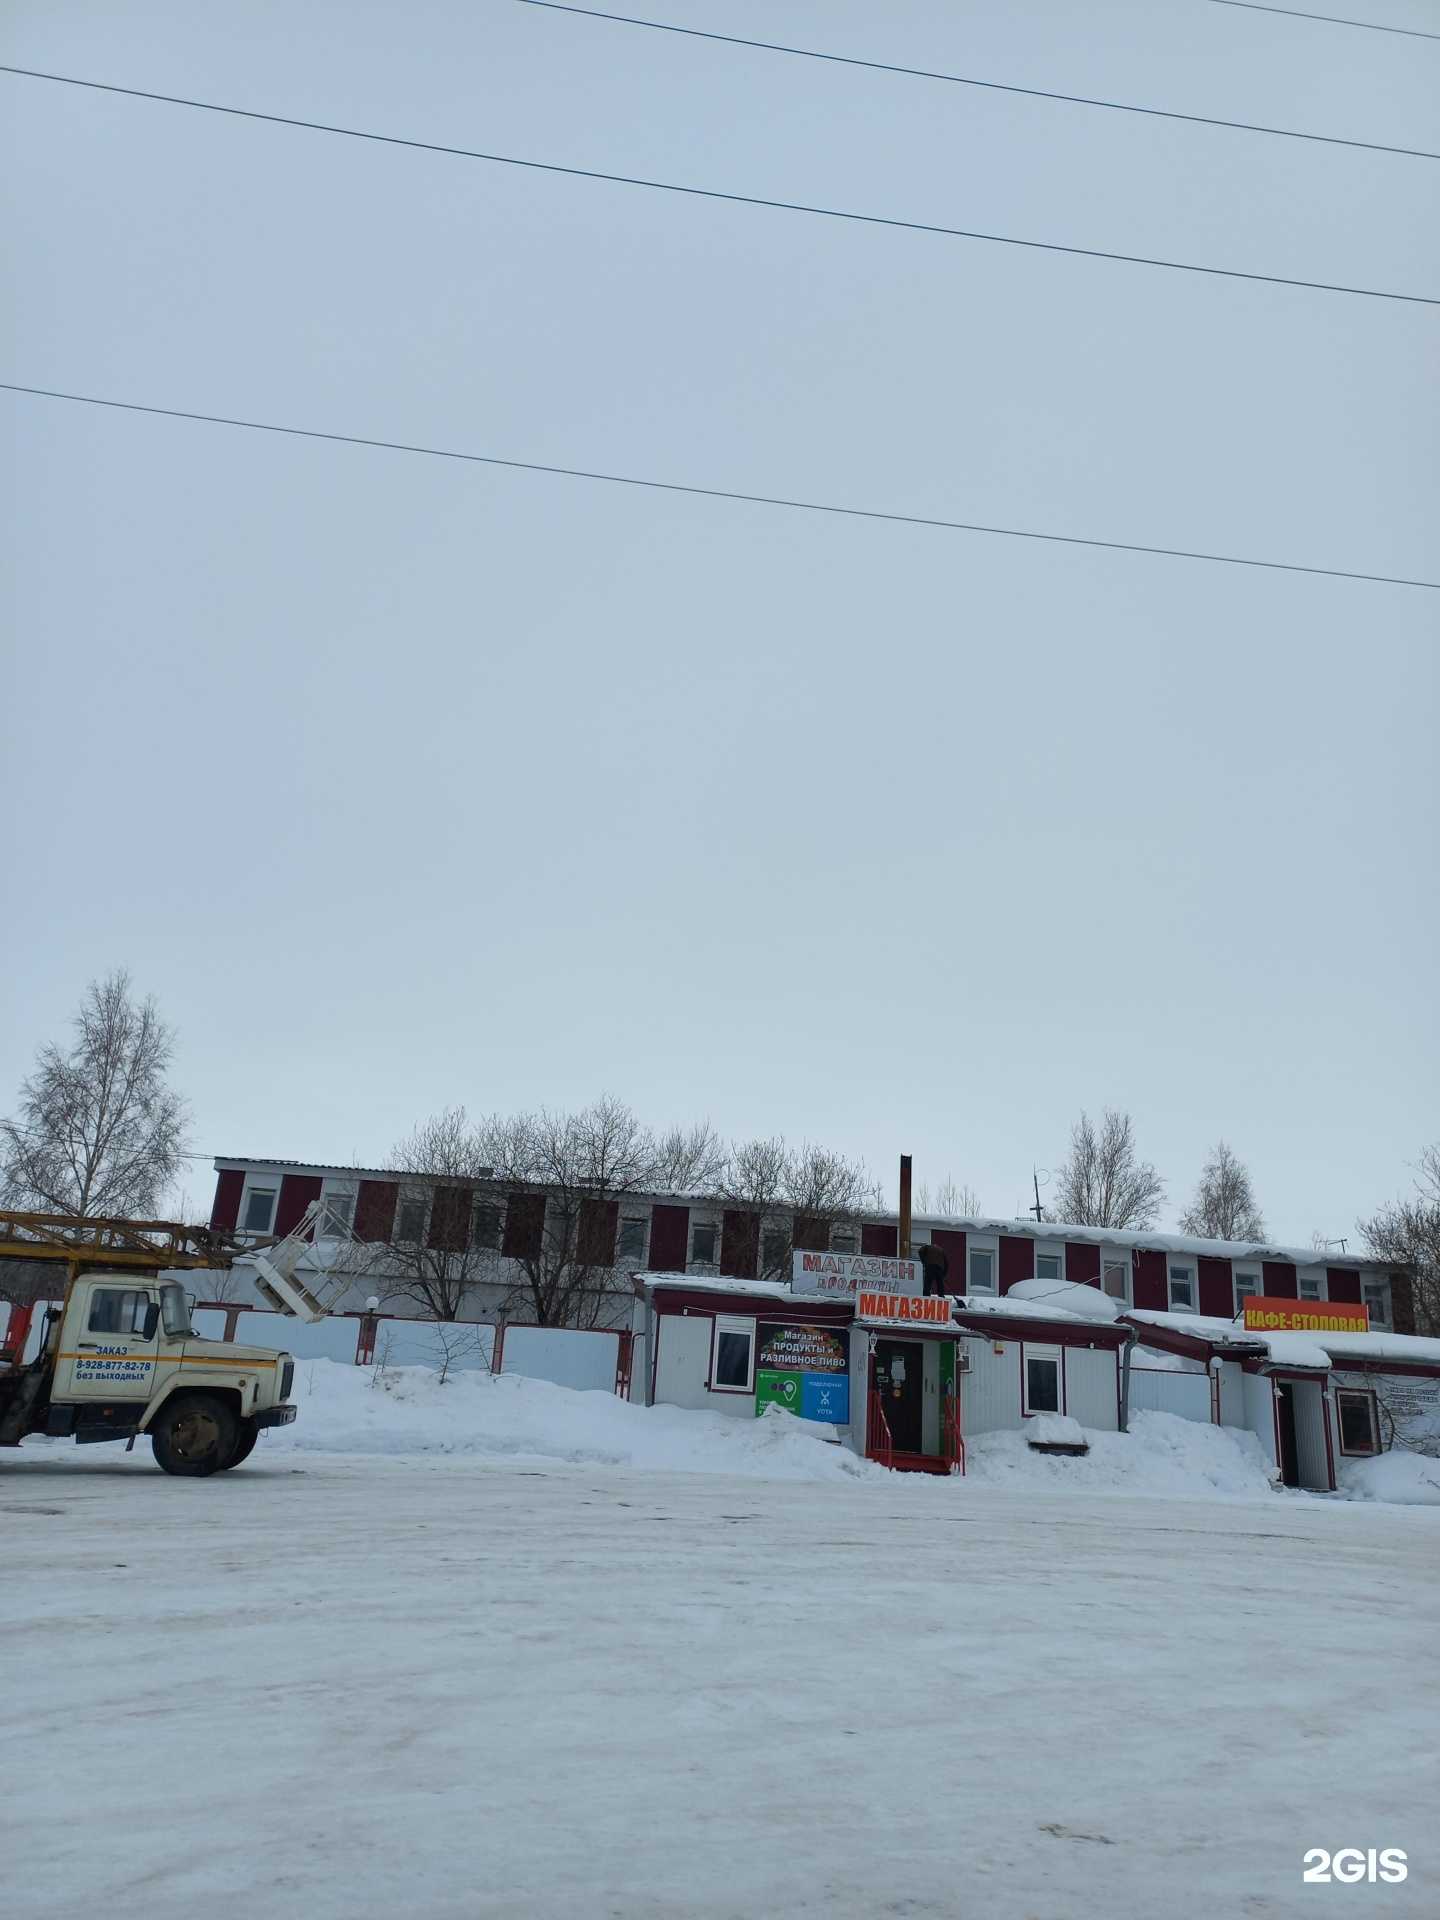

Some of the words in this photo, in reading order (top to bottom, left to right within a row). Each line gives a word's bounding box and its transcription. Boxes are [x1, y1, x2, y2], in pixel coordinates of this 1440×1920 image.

[803, 1253, 915, 1281] МАГАЗИН
[859, 1293, 950, 1321] МАГАЗИН
[784, 1330, 824, 1342] Магазин
[96, 1346, 128, 1356] ЗАКАЗ
[773, 1342, 825, 1354] ПРОДУКТЫ
[760, 1353, 817, 1365] РАЗЛИВНОЕ
[819, 1357, 846, 1367] ПИВО
[76, 1370, 93, 1380] без
[95, 1372, 145, 1381] выходных
